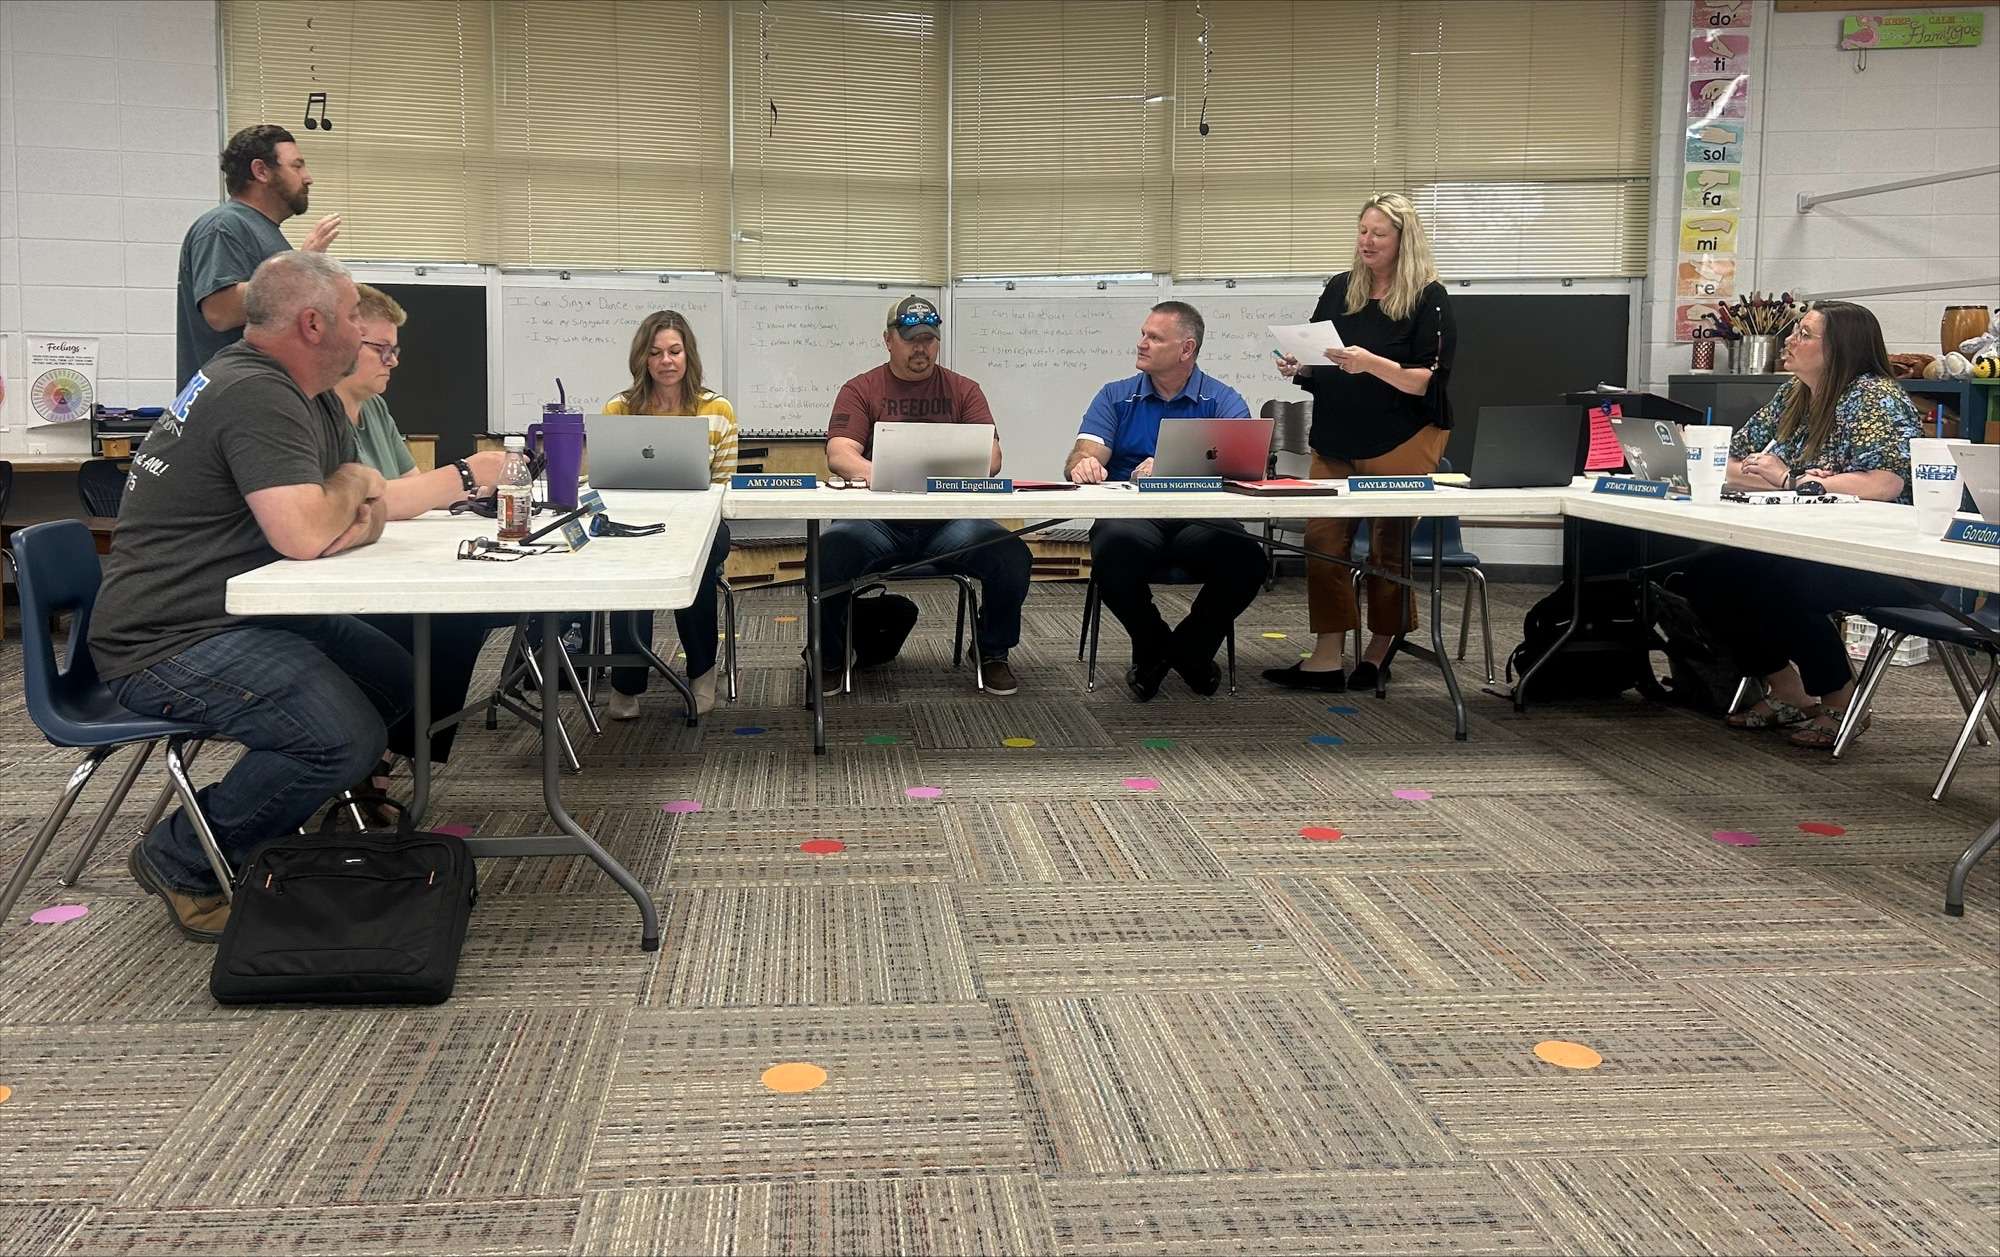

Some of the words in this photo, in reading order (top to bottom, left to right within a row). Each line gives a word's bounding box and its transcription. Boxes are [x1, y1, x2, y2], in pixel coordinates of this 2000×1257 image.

[1713, 57, 1726, 71] ti
[1703, 147, 1726, 162] sol
[1701, 193, 1721, 207] fa
[1697, 237, 1718, 251] mi
[1694, 283, 1715, 296] re
[46, 342, 81, 354] Feelings
[881, 398, 954, 418] FREEDOM
[1916, 465, 1956, 474] HYPER
[746, 478, 769, 487] AMY
[770, 478, 803, 487] JONES
[934, 480, 960, 489] Brent
[961, 480, 1004, 492] Engelland
[1138, 481, 1167, 490] CURTIS
[1168, 481, 1222, 490] NIGHTINGALE
[1356, 480, 1387, 489] GAYLE
[1388, 480, 1425, 489] DAMATO
[1604, 481, 1625, 491] STACI
[1627, 483, 1658, 494] WATSON
[1962, 524, 1998, 544] Gordon
